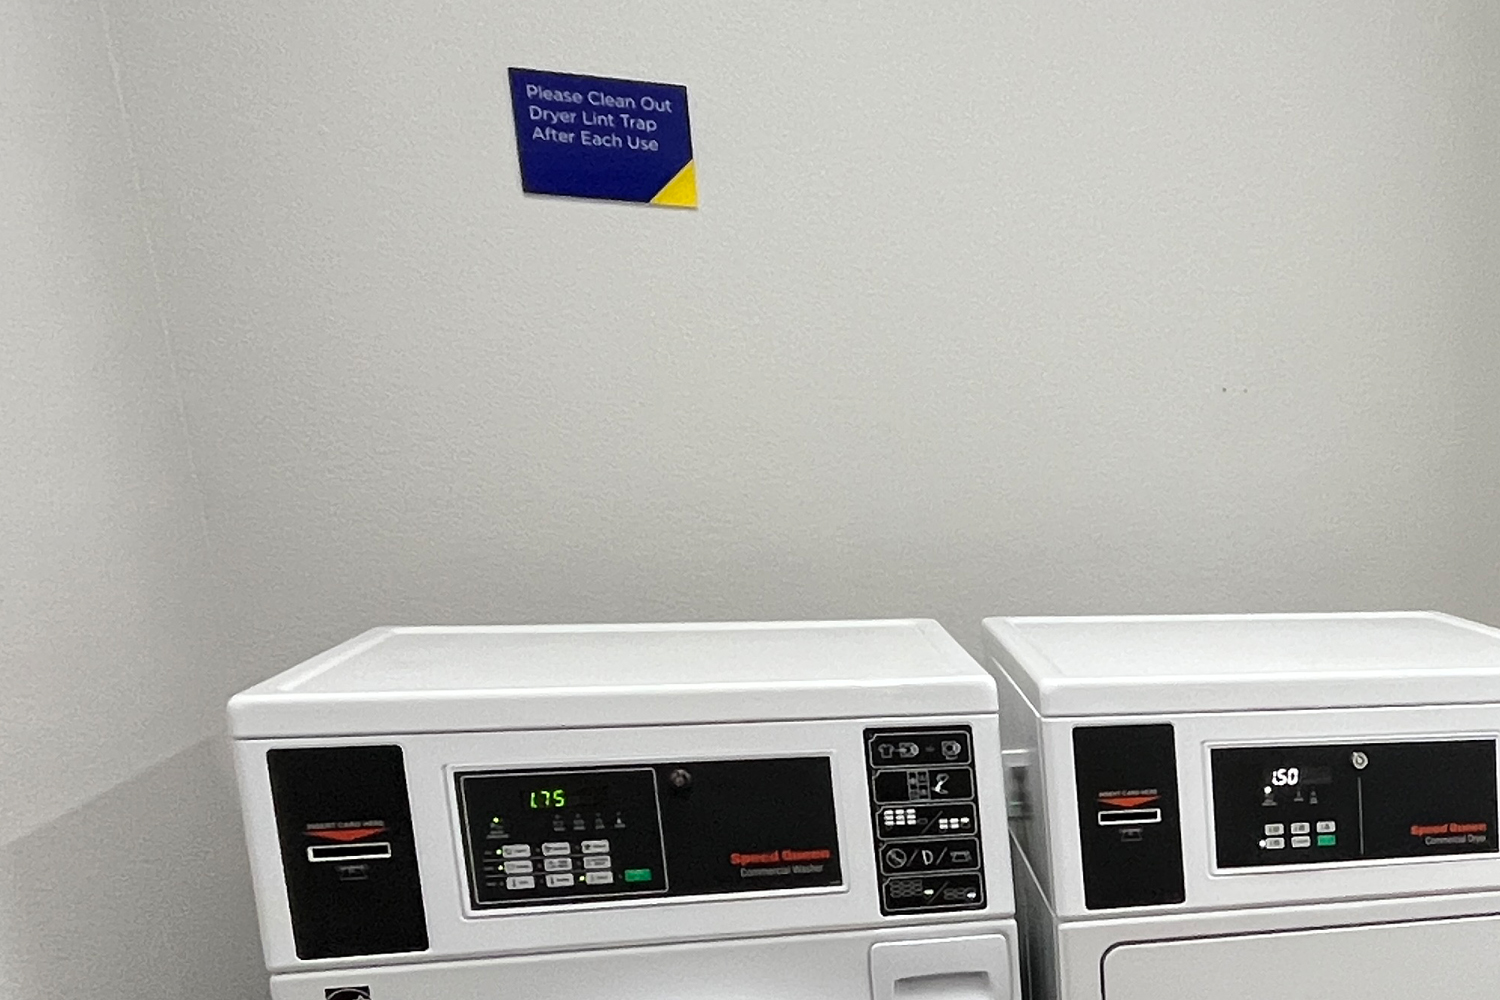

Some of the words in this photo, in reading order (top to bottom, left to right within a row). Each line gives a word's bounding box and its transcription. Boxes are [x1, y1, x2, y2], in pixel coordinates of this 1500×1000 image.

[526, 84, 583, 105] Please
[587, 91, 636, 109] Clean
[640, 96, 673, 113] Out
[529, 105, 577, 124] Dryer
[582, 111, 615, 127] Lint
[619, 113, 658, 133] Trap
[532, 127, 575, 143] After
[581, 131, 623, 148] Each
[627, 136, 659, 151] Use
[730, 850, 780, 866] Speed
[781, 848, 831, 862] Queen
